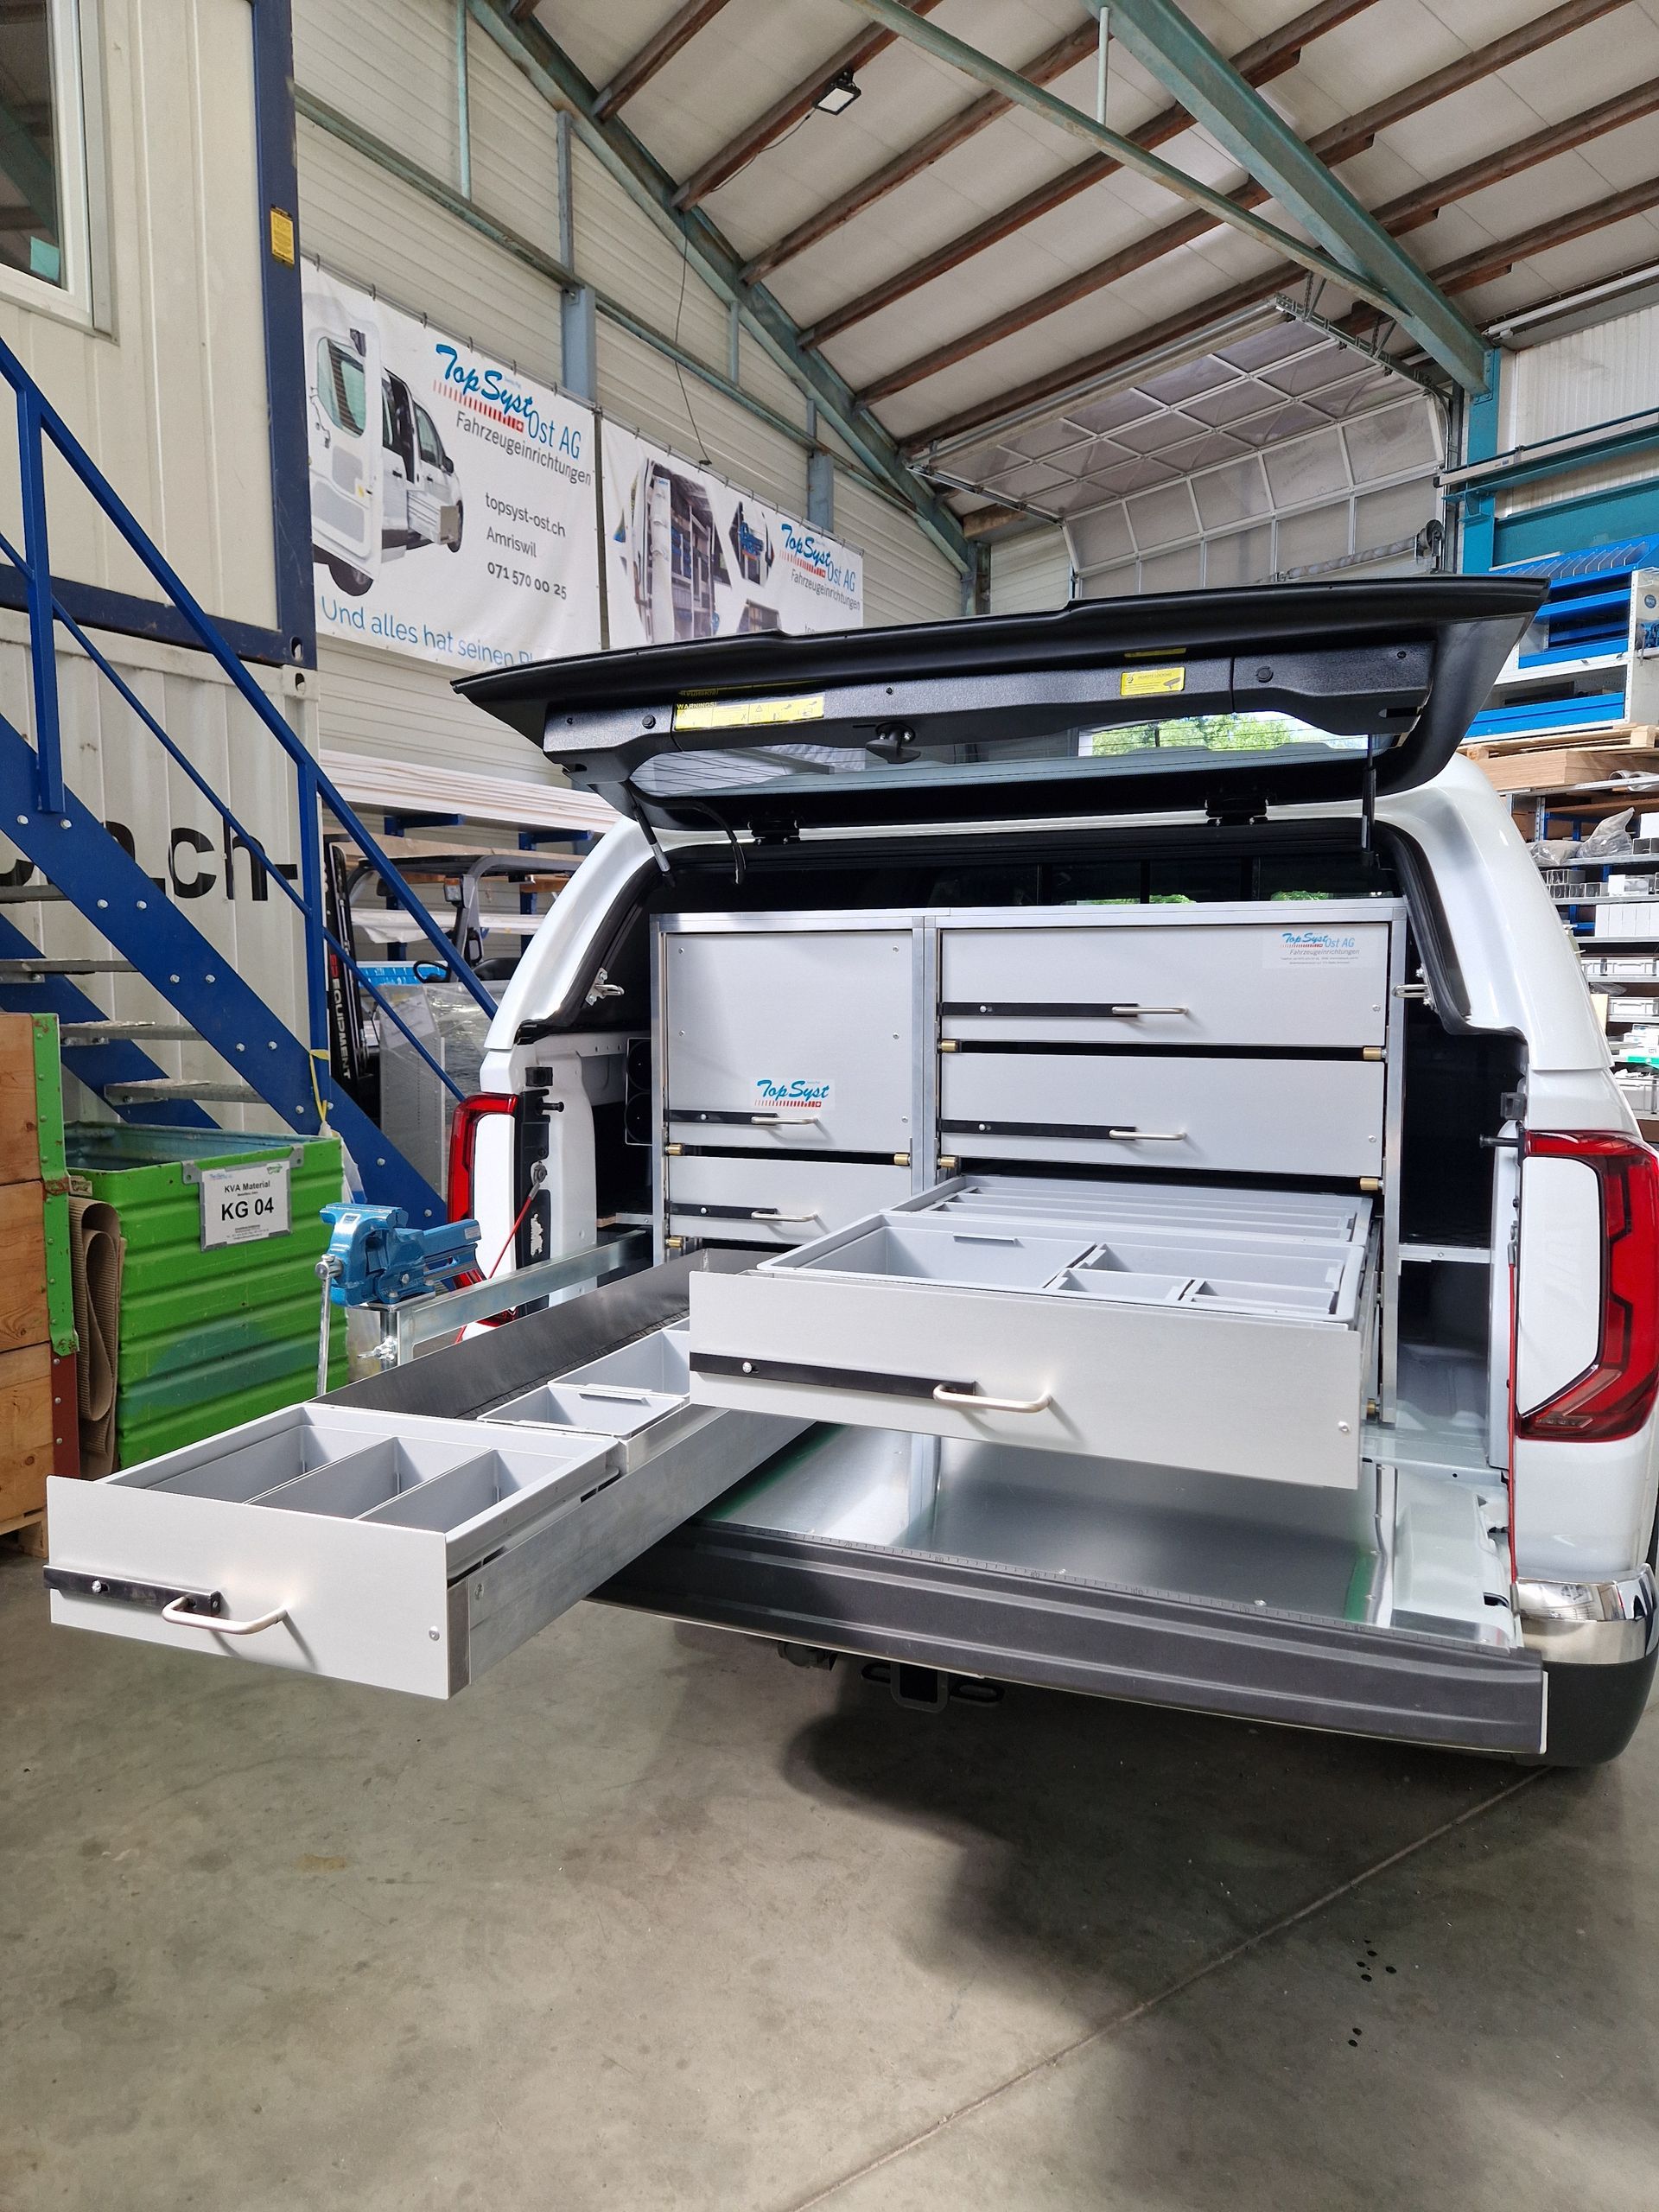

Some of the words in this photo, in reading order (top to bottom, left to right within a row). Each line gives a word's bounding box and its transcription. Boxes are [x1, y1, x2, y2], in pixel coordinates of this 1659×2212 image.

[456, 410, 592, 486] Fahrzeugeinrichtungen
[528, 410, 556, 448] Ost
[559, 426, 582, 460] AG
[486, 492, 566, 537] topsyst-ost.ch
[486, 525, 537, 558] Amriswil
[487, 562, 510, 580] 071
[512, 570, 531, 588] 570
[534, 578, 550, 593] 00
[553, 583, 567, 601] 25
[791, 569, 860, 610] Fahrzeugeinrichtungen
[827, 561, 842, 587] Ost
[843, 569, 855, 592] AG
[321, 595, 365, 630] Und
[371, 613, 418, 644] alles
[423, 625, 453, 652] hat
[458, 639, 514, 666] seinen
[677, 701, 717, 710] WARNINGS!
[1342, 938, 1355, 948] AG
[333, 978, 351, 1079] EQUIPMENT
[224, 1185, 241, 1193] KVA
[242, 1180, 270, 1192] Material
[221, 1201, 249, 1221] KG
[254, 1197, 274, 1216] 04
